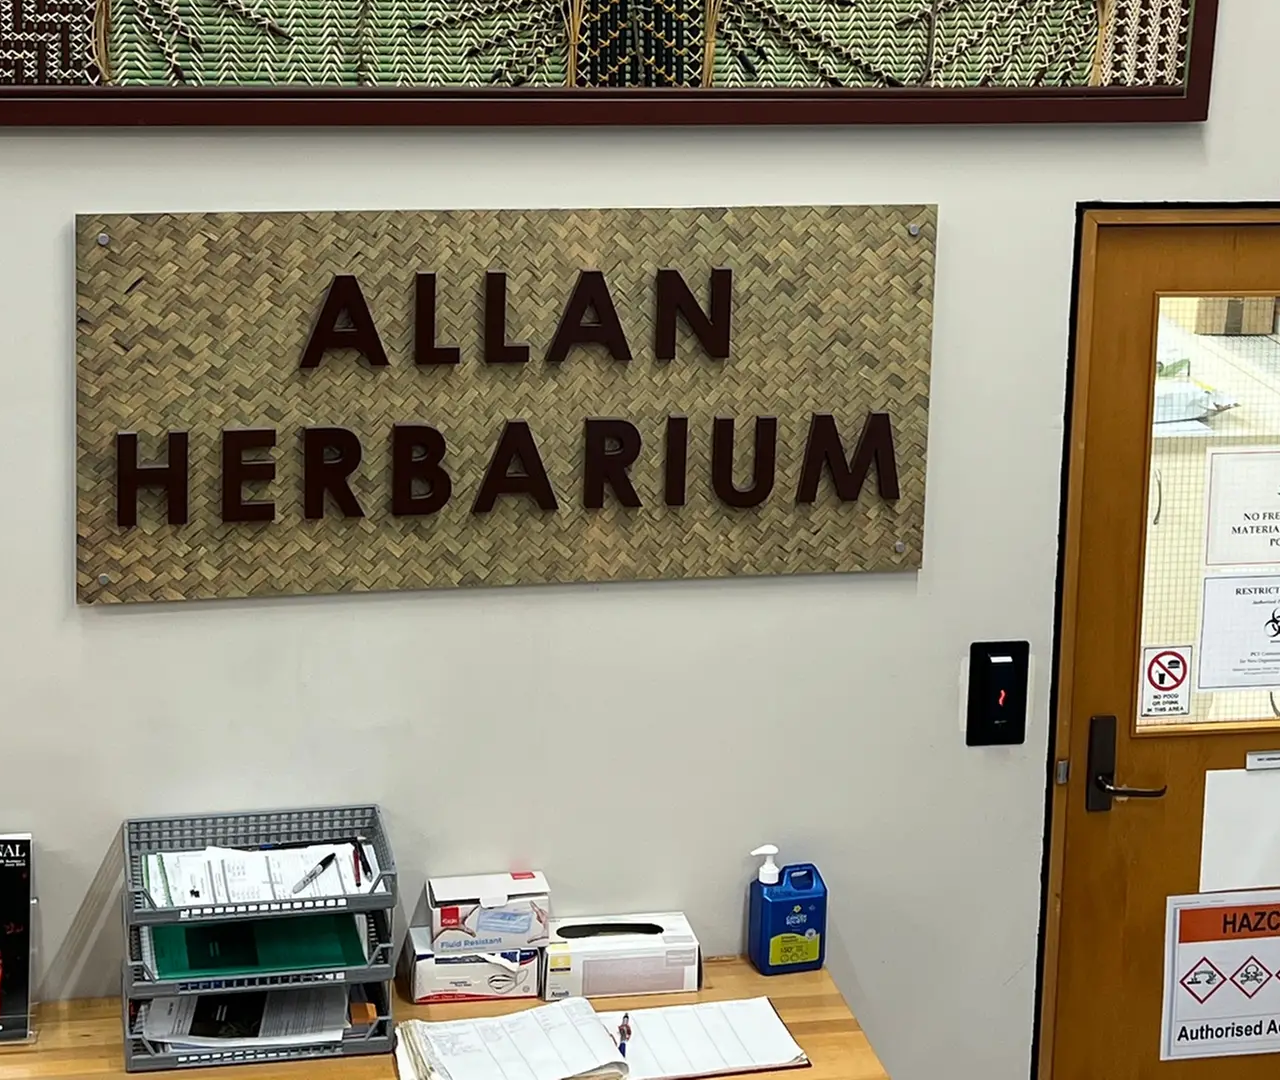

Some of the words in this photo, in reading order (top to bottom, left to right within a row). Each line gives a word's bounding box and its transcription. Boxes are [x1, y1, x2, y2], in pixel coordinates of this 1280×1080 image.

[299, 266, 732, 369] ALLAN
[116, 411, 901, 526] HERBARIUM
[1244, 512, 1259, 521] NO
[441, 940, 461, 948] Fluid
[464, 938, 501, 946] Resistant
[1177, 1021, 1262, 1042] Authorised
